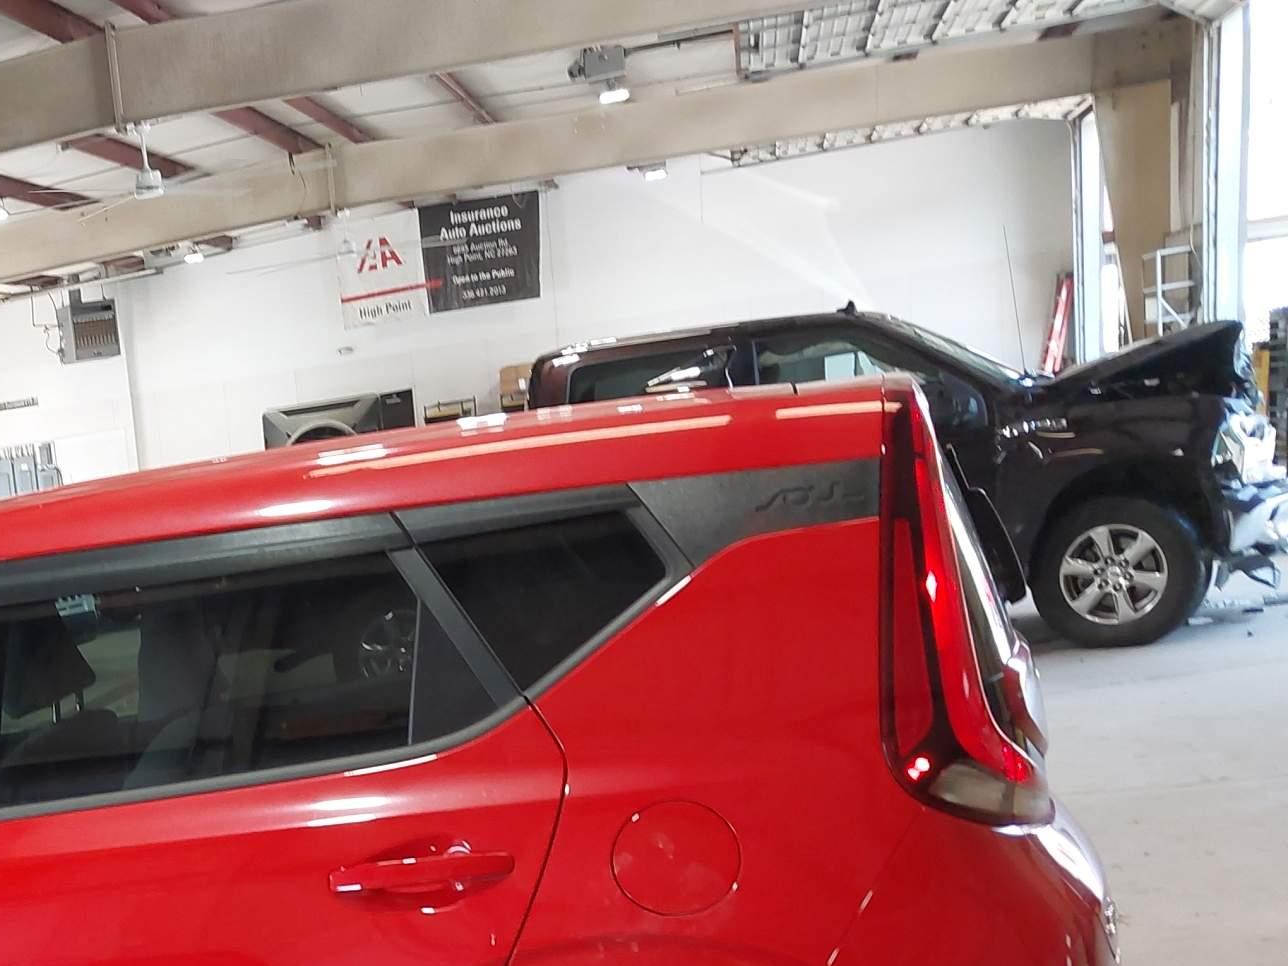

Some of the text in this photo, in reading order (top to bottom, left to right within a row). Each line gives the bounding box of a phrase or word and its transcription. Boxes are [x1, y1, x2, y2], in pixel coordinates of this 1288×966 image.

[450, 205, 509, 225] Insurance
[440, 218, 522, 242] Auto Auctions
[452, 267, 515, 287] Open to the Public
[359, 299, 412, 319] High Point
